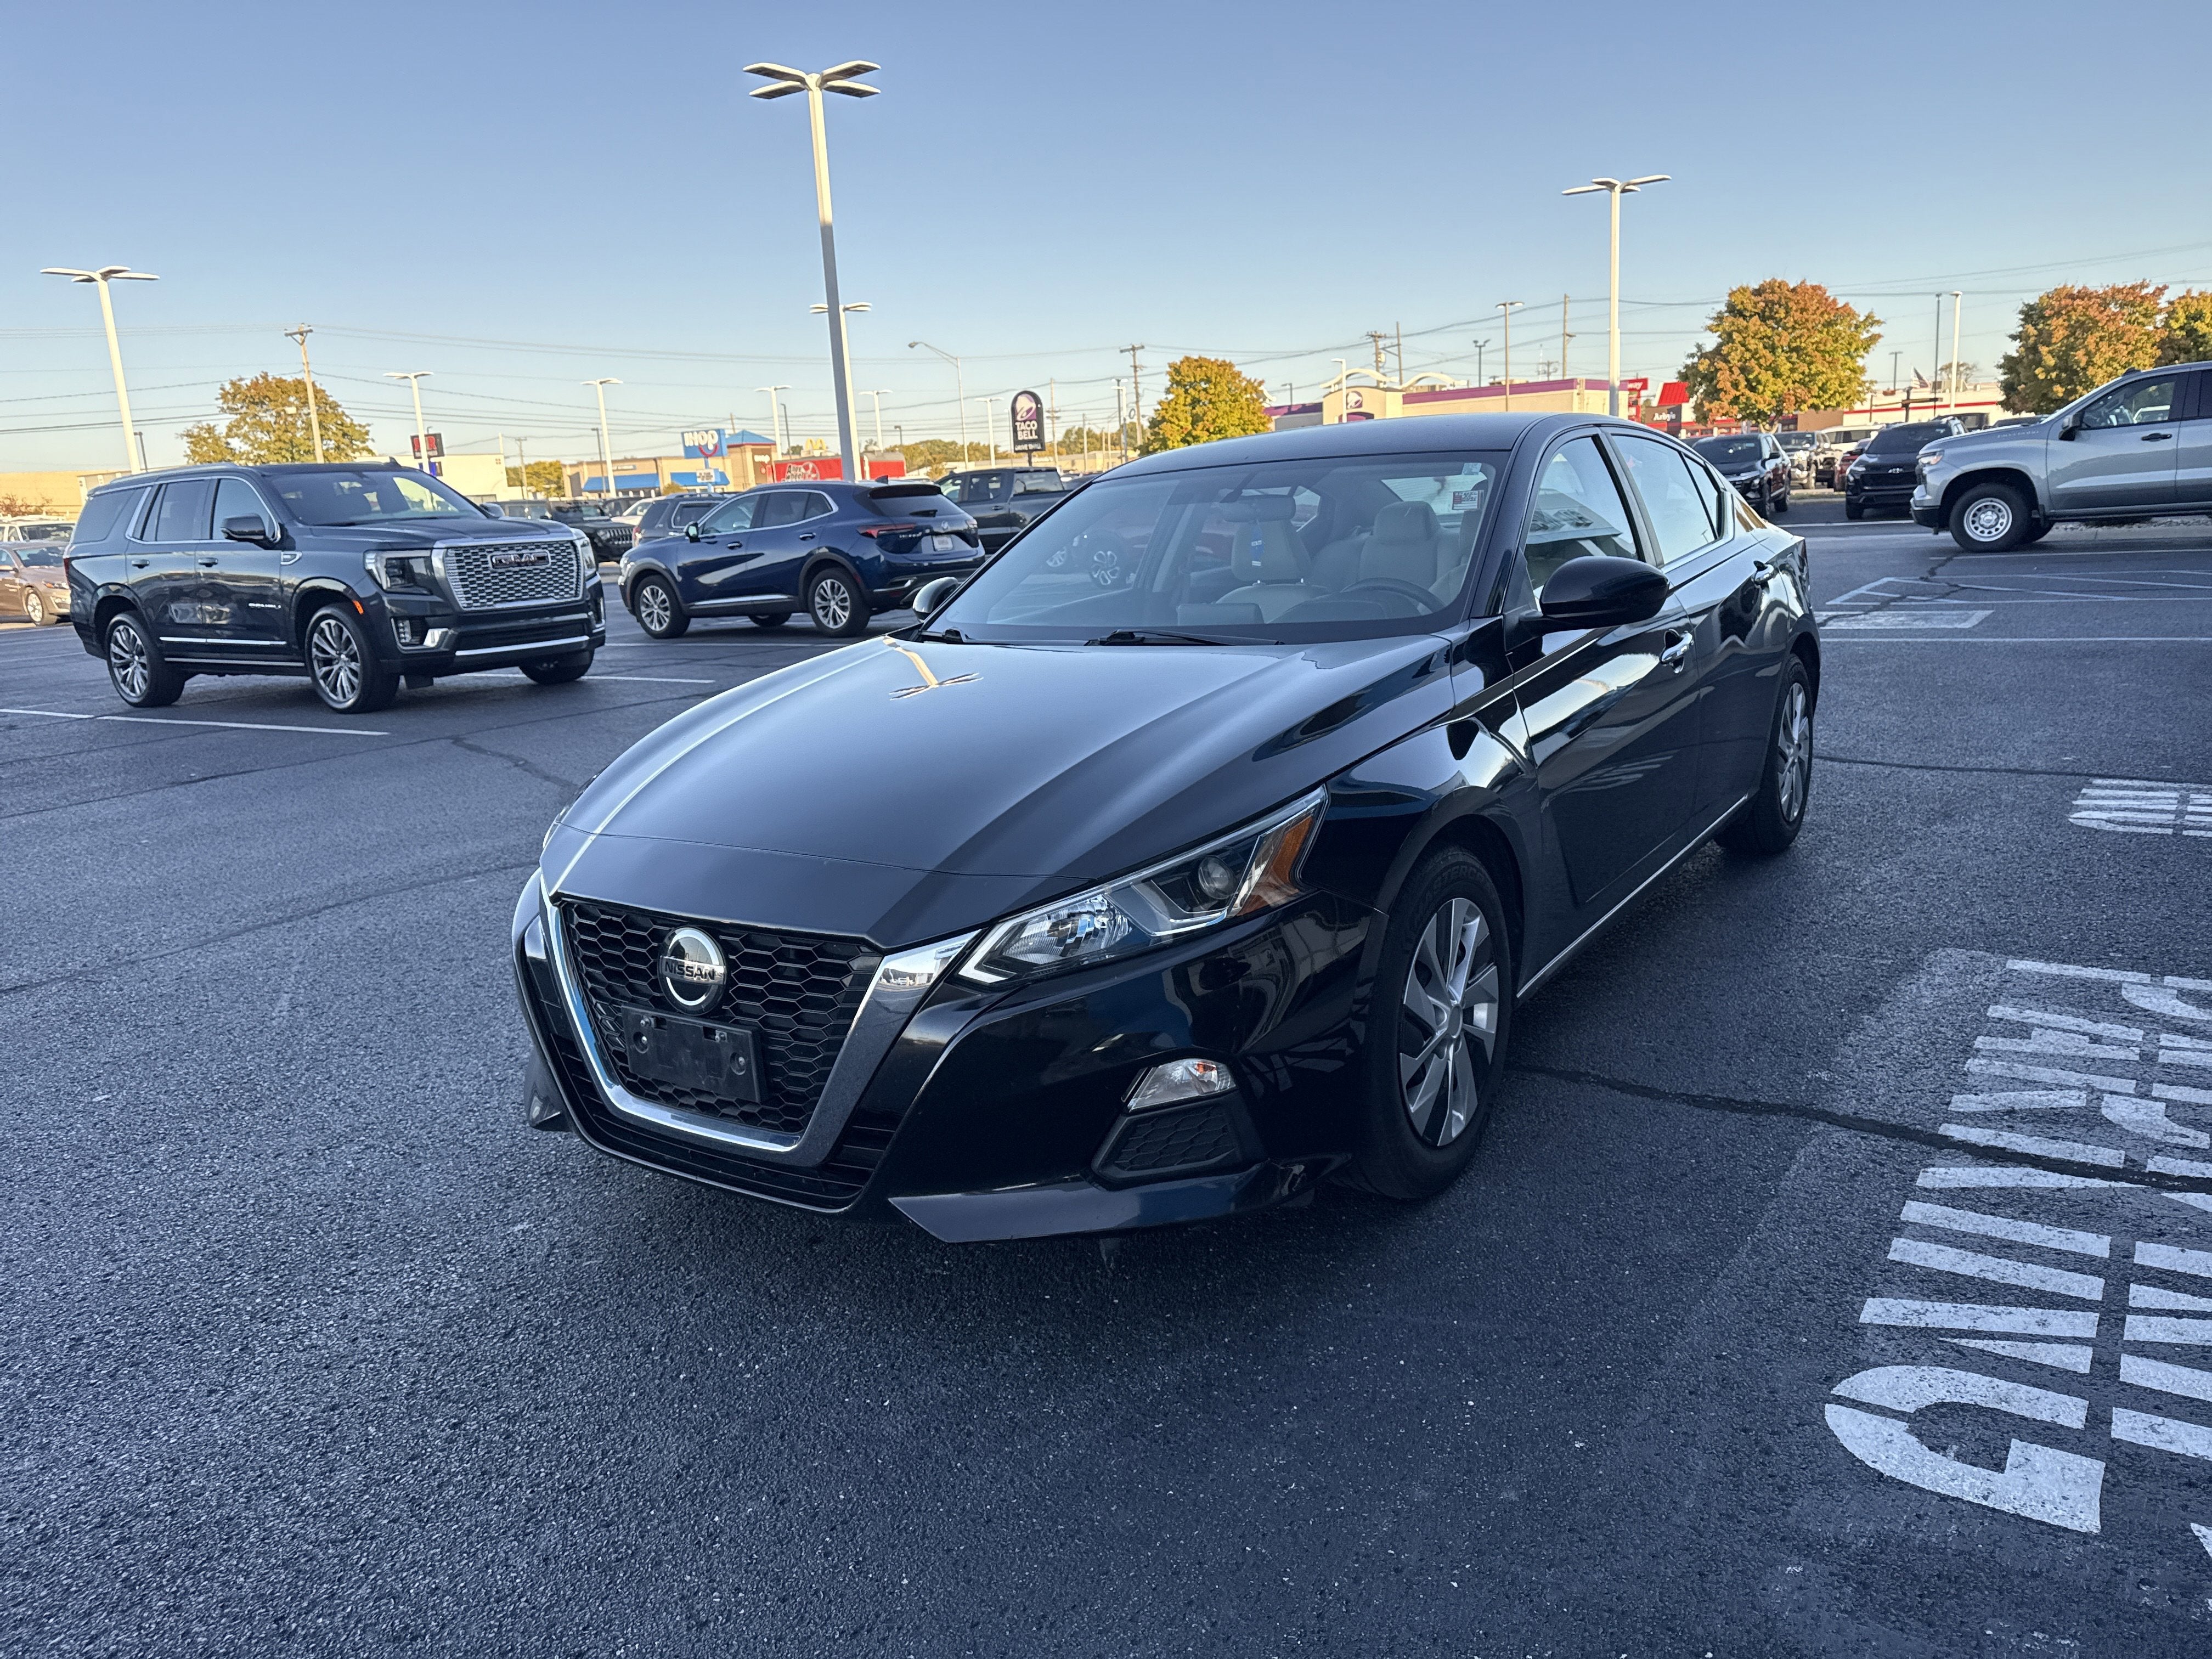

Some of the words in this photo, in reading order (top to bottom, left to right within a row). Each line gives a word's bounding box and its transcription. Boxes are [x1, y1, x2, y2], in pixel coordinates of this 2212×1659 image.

[1653, 411, 1676, 422] Arby's
[1015, 420, 1037, 431] TACO
[684, 430, 719, 450] IHOP
[1017, 430, 1039, 440] BELL
[492, 552, 549, 569] GMC
[665, 961, 715, 980] NISSAN
